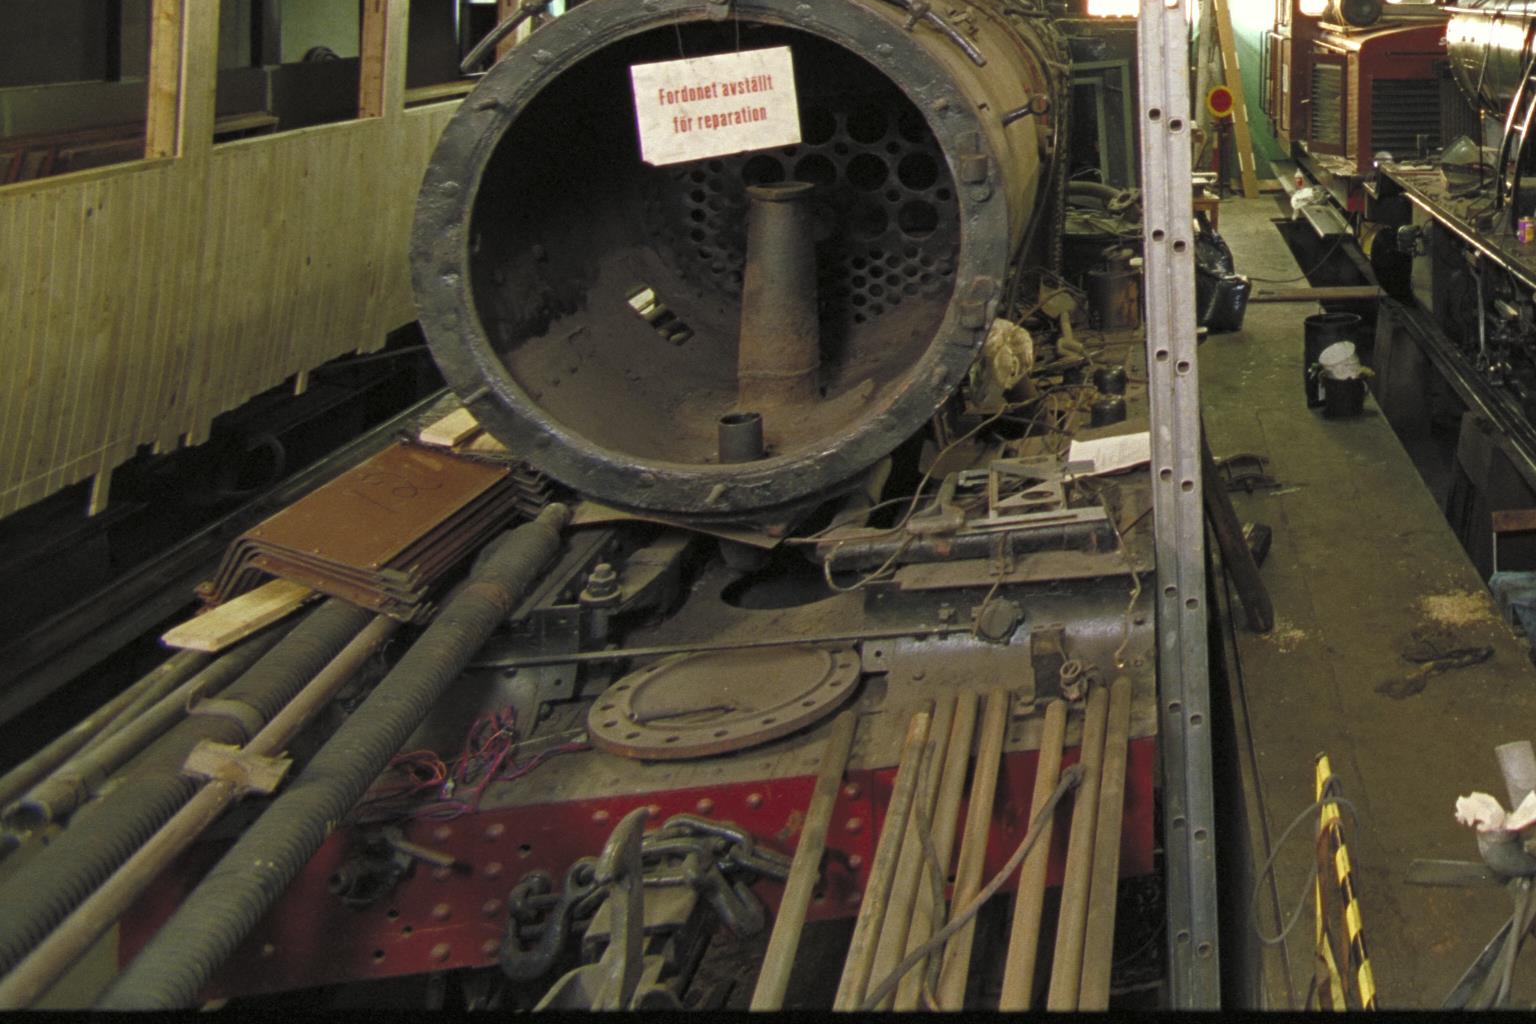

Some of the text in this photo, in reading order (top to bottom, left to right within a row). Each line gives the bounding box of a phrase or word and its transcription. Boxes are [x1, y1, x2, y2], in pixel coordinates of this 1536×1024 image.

[658, 74, 774, 105] Fordonet avställt
[697, 106, 768, 130] reparation
